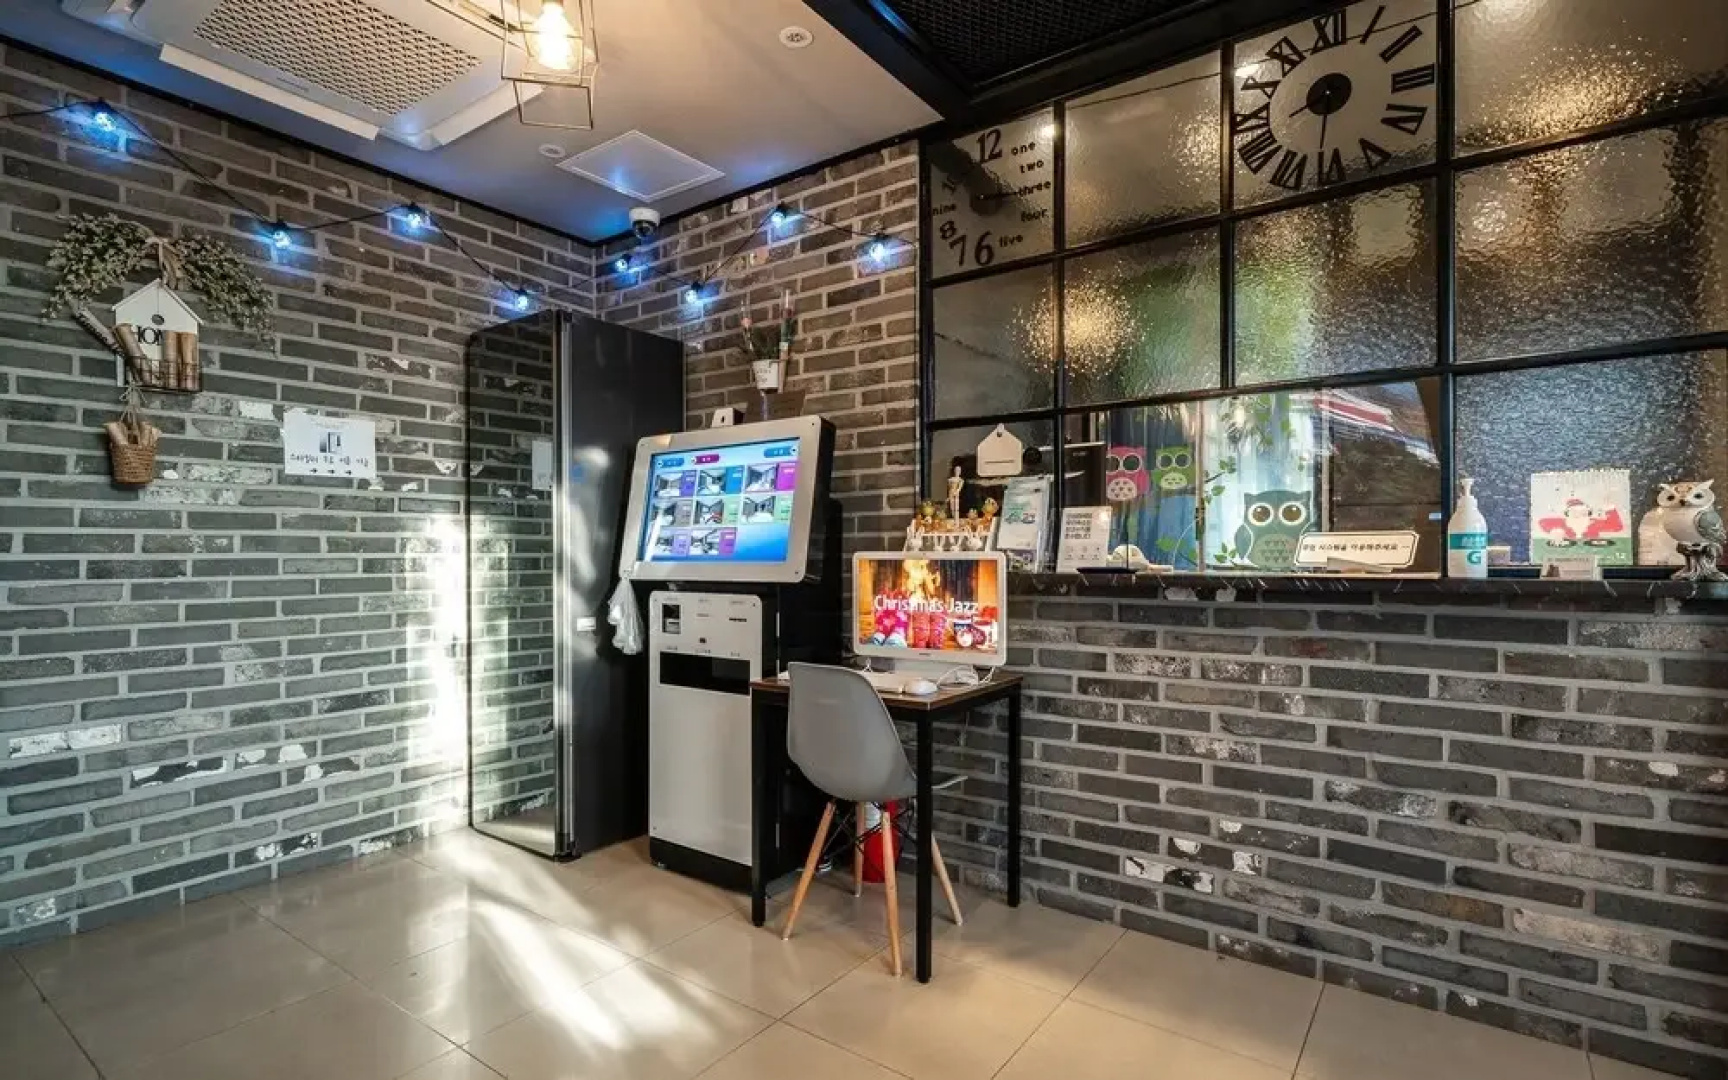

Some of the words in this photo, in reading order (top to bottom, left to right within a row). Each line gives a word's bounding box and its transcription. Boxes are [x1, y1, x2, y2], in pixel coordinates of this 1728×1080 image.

[1310, 8, 1346, 55] XII
[1391, 63, 1435, 94] III
[976, 129, 1003, 164] 12
[1010, 141, 1036, 156] one
[1020, 160, 1044, 174] two
[1018, 180, 1052, 197] three
[1021, 208, 1049, 222] four
[939, 220, 957, 240] 8
[950, 234, 967, 266] 7
[974, 230, 995, 266] 6
[875, 594, 944, 613] Christmas
[947, 597, 979, 614] Jazz
